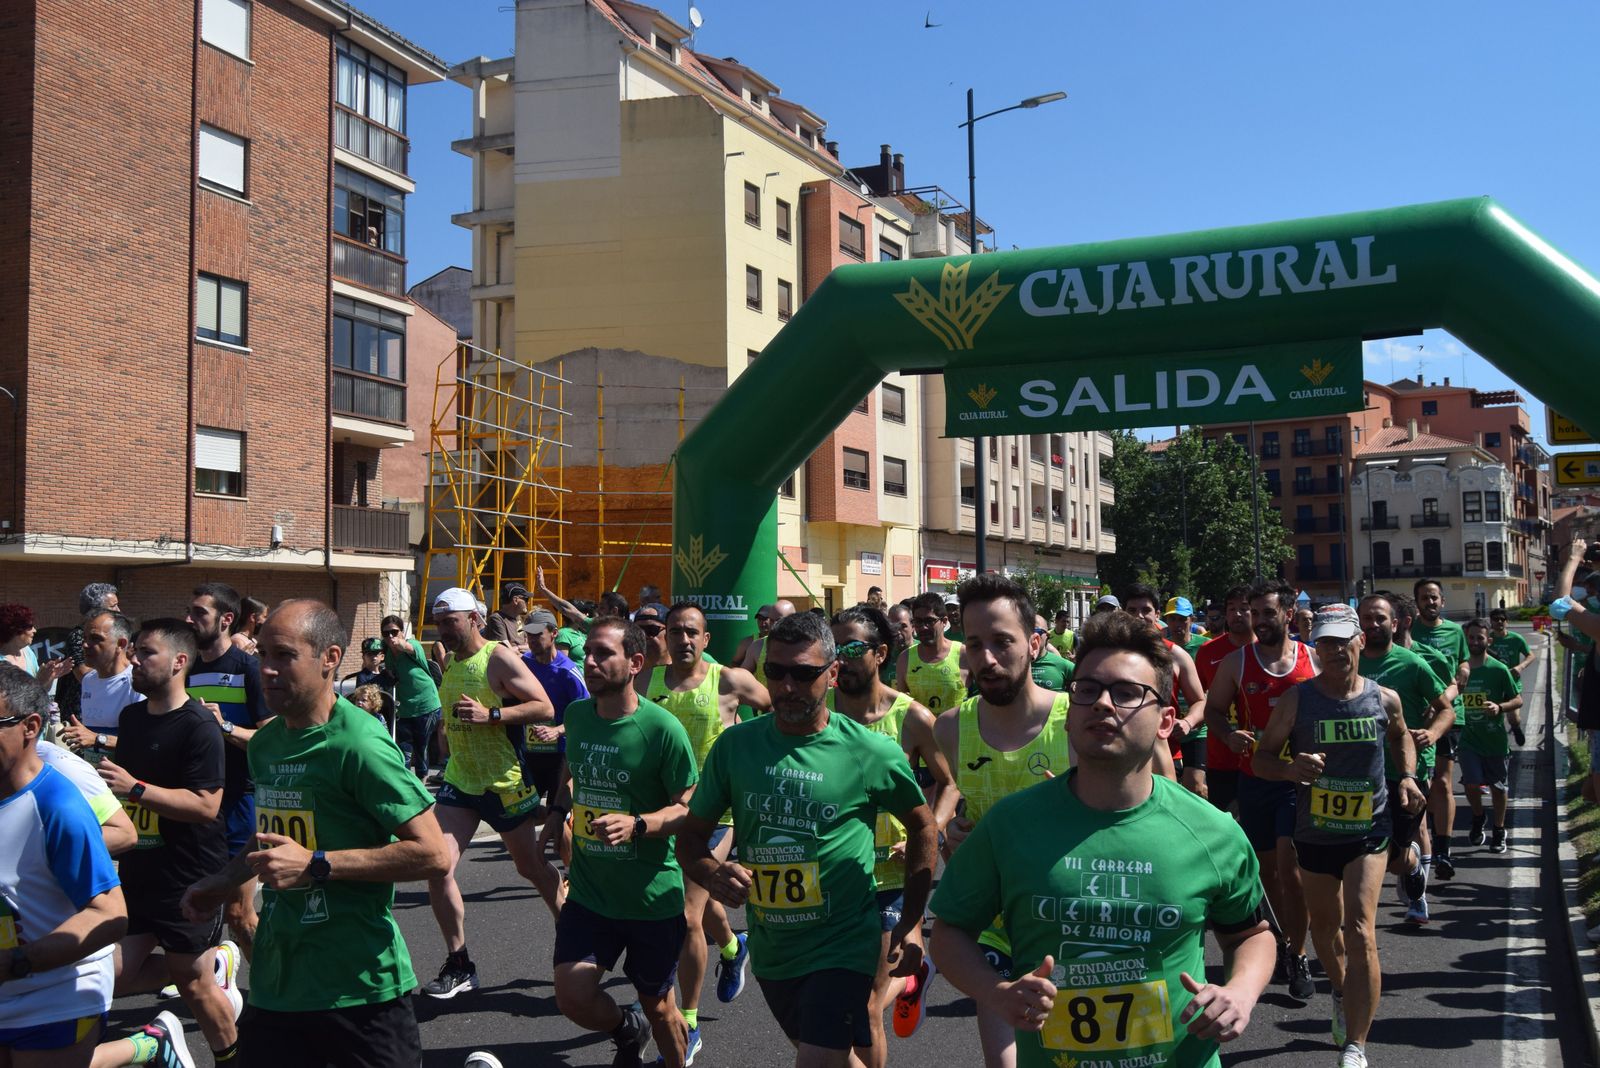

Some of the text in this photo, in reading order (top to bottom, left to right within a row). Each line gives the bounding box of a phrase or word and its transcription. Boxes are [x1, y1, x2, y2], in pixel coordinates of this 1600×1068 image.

[1019, 235, 1397, 316] CAJA RURAL
[1018, 364, 1277, 418] SALIDA
[1289, 386, 1346, 399] CAJA RURAL
[960, 410, 1008, 420] CAJA RURAL
[1320, 721, 1326, 741] I
[1335, 719, 1377, 741] RUN
[782, 768, 824, 782] CARRERA
[1319, 793, 1365, 817] 197
[760, 814, 817, 831] DE ZAMORA
[755, 845, 805, 856] FUNDACION
[756, 854, 806, 863] CAJA RURAL
[1065, 856, 1153, 874] VII CARRERA
[752, 868, 806, 903] 178
[765, 912, 820, 923] CAJA RURAL
[1062, 924, 1151, 943] DE ZAMORA
[1069, 957, 1146, 975] FUNDACION
[1070, 969, 1147, 986] CAJA RURAL
[1068, 993, 1135, 1044] 87
[1119, 1052, 1168, 1068] RURAL
